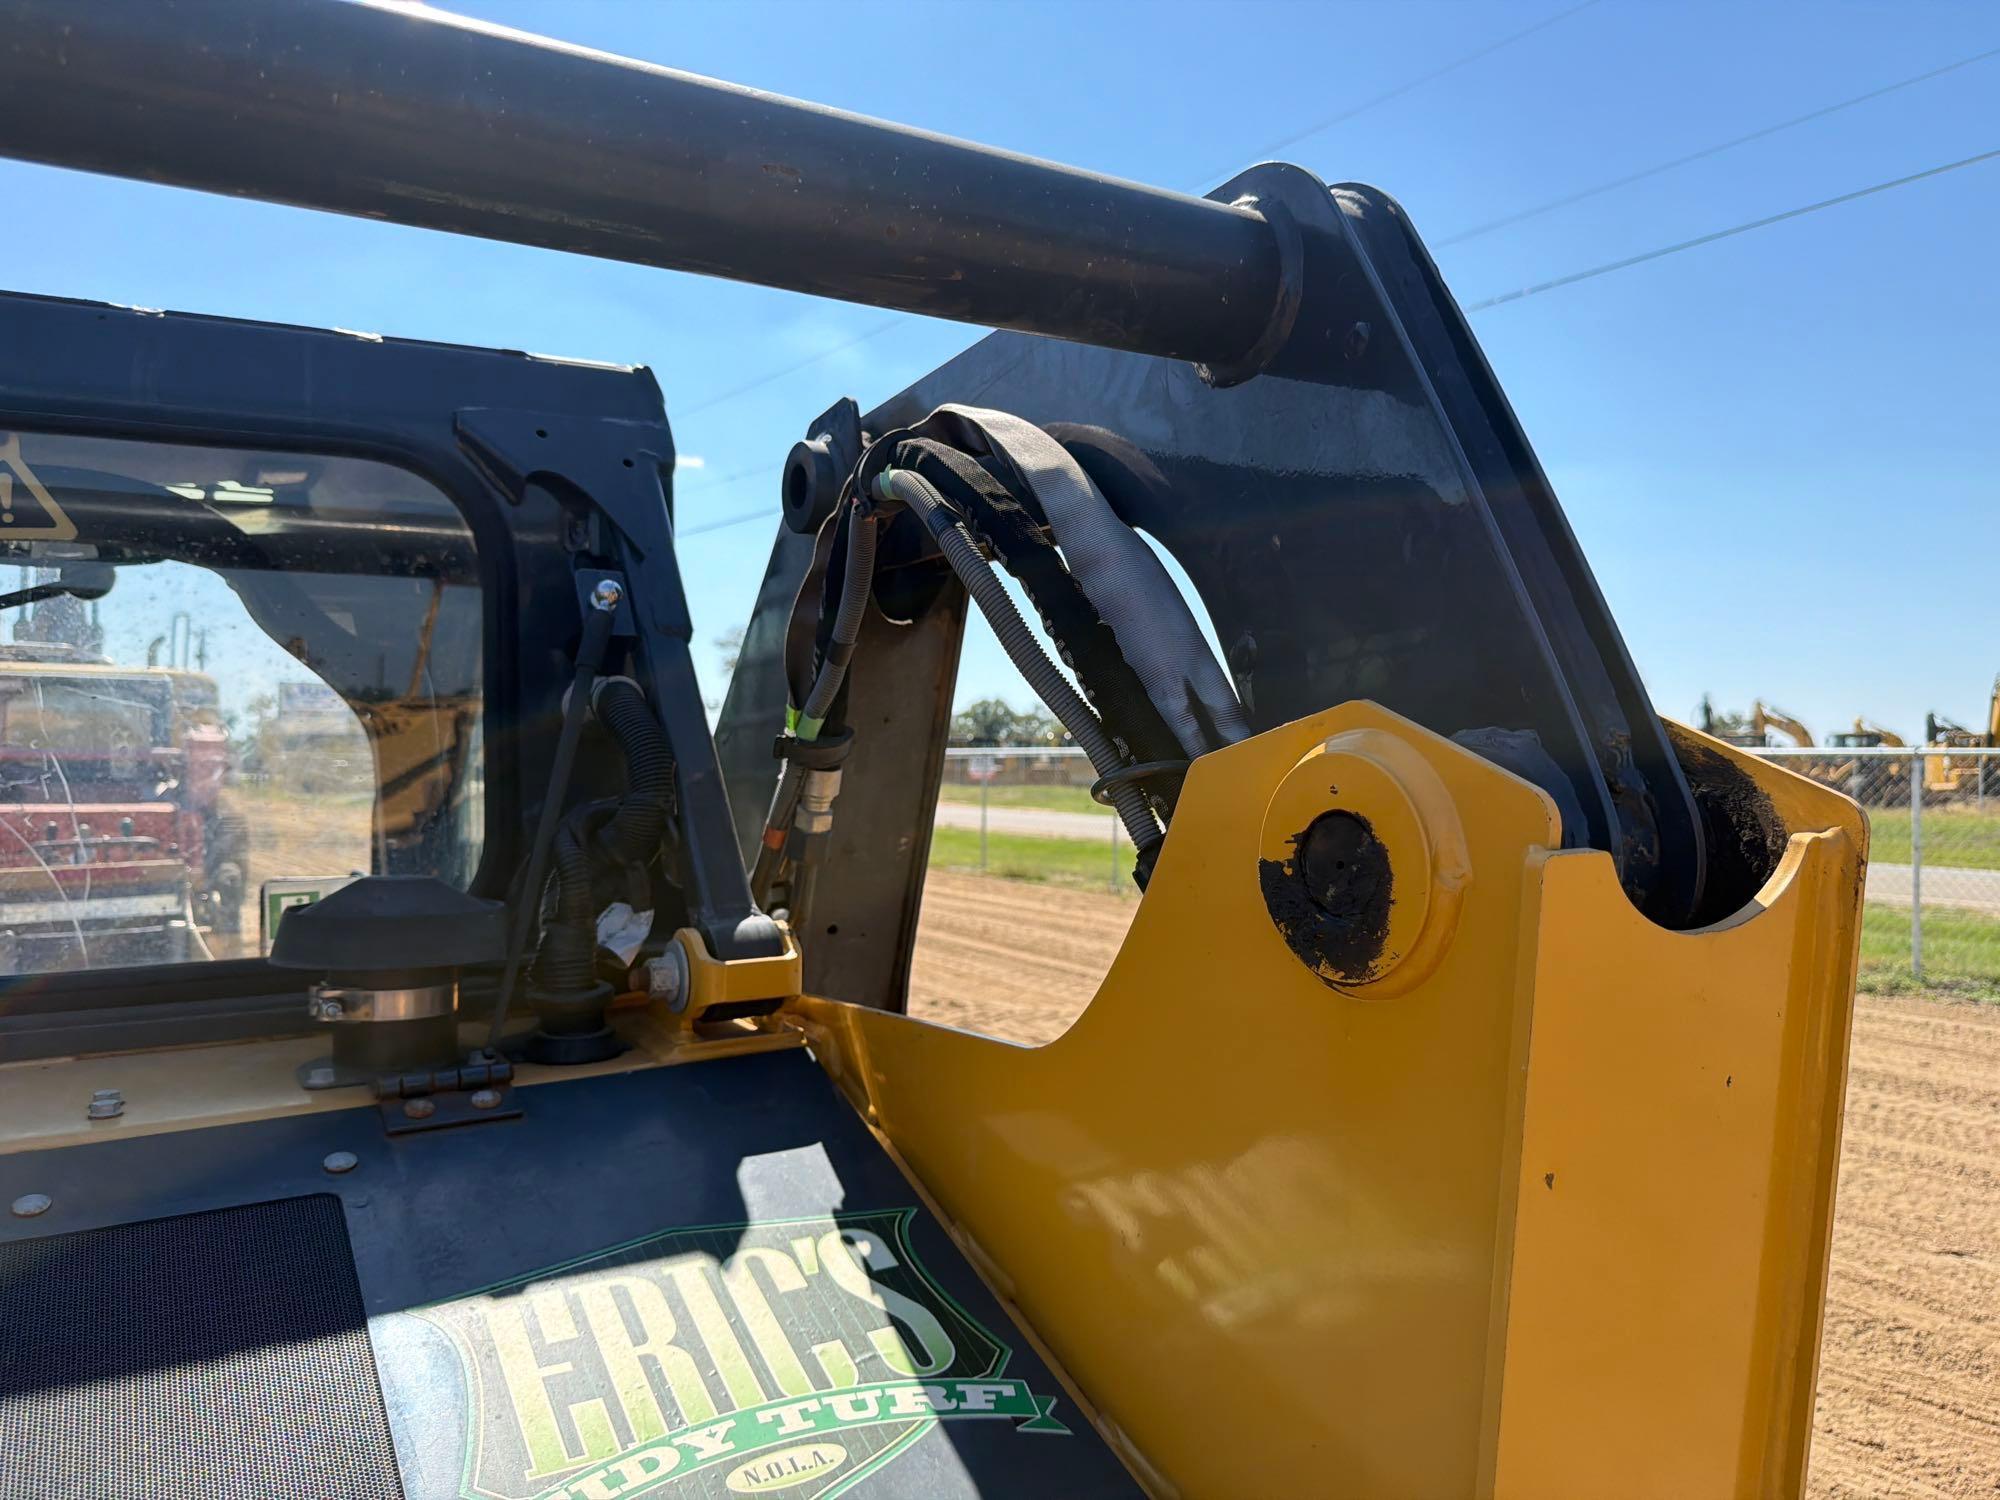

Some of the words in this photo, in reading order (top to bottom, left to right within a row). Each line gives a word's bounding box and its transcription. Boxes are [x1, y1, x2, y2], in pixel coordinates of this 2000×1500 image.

[482, 1228, 956, 1481] ERIC'S
[543, 1419, 737, 1500] IDY
[756, 1384, 1017, 1436] TURF
[743, 1450, 836, 1487] N.O.L.A.
